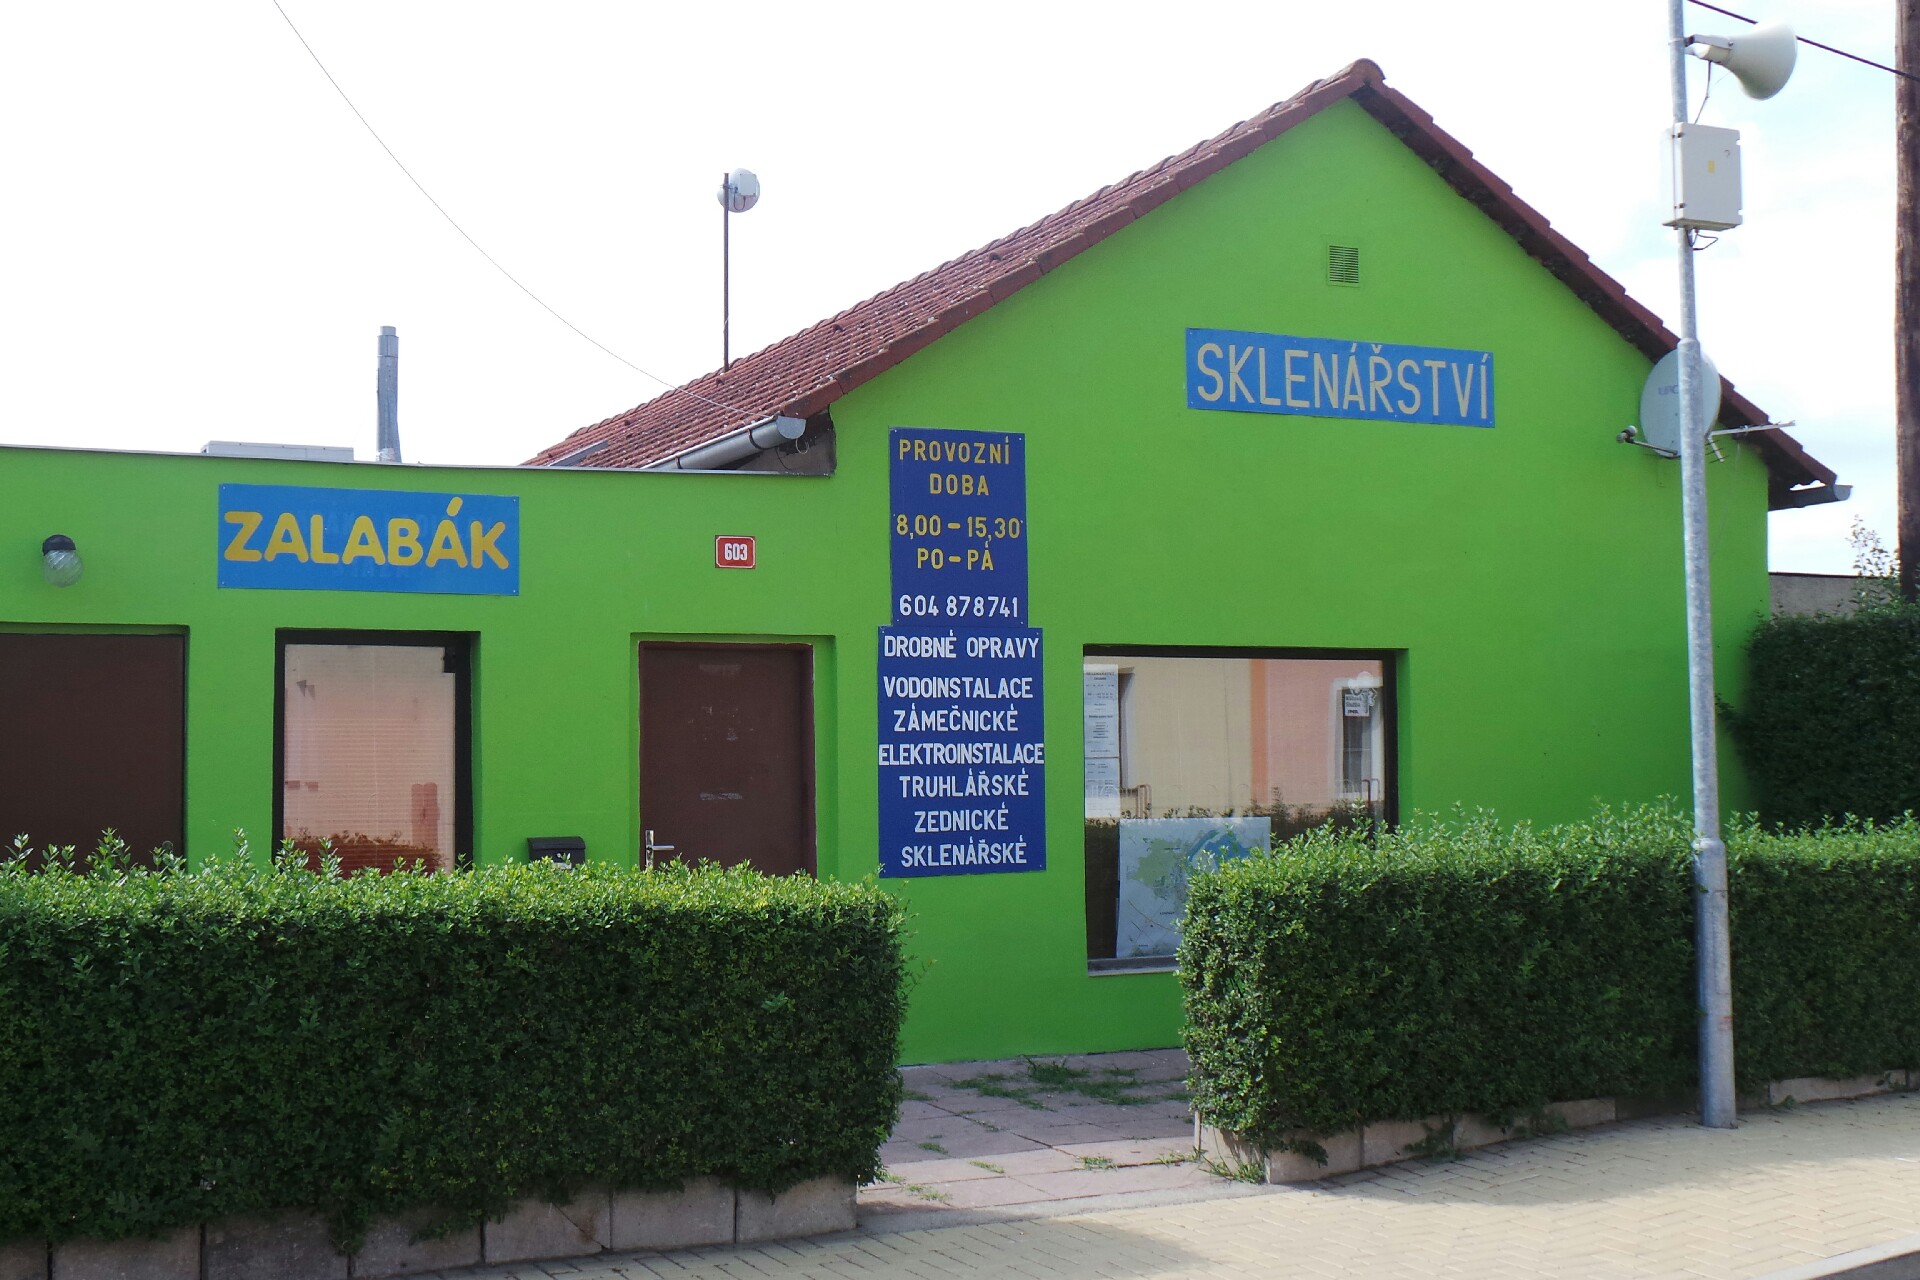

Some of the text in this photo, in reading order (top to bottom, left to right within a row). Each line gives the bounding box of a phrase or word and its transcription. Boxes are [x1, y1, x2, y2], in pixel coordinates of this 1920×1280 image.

[1197, 342, 1488, 420] SKLENÁŘSTVÍ
[899, 436, 1010, 464] PROVOZNÍ
[929, 473, 989, 495] DOBA
[224, 496, 509, 569] ZALABÁK
[724, 543, 748, 561] 603
[899, 595, 1018, 617] 604 878741
[884, 629, 1039, 658] DROBNÉ OPRAVY
[883, 676, 1033, 698] VODOINSTALACE
[893, 702, 1018, 732] ZÁMEČNICKÉ
[878, 743, 1044, 766] ELEKTROINSTALACE
[899, 768, 1029, 798] TRUHLÁŘSKÉ
[914, 802, 1009, 833] ZEDNICKÉ
[901, 834, 1027, 868] SKLENÁŘSKÉ
